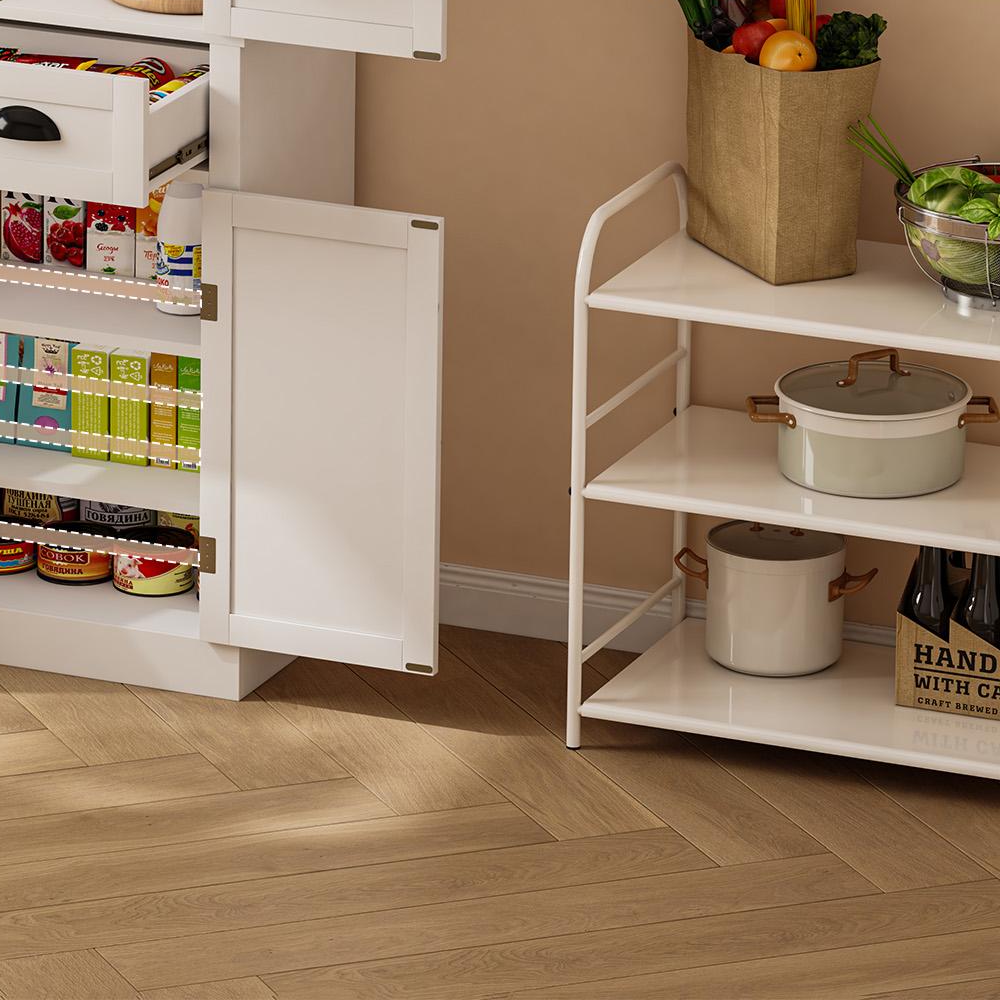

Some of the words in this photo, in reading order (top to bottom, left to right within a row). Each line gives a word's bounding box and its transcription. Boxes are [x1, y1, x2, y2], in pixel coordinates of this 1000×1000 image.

[86, 511, 148, 524] ГОВЯДИНА
[40, 549, 84, 562] СОВОК
[41, 563, 83, 575] ГОВЯДИНА
[914, 643, 998, 674] HAND
[914, 673, 970, 696] WITH
[917, 696, 952, 708] CRAFT
[955, 702, 999, 715] BREWED
